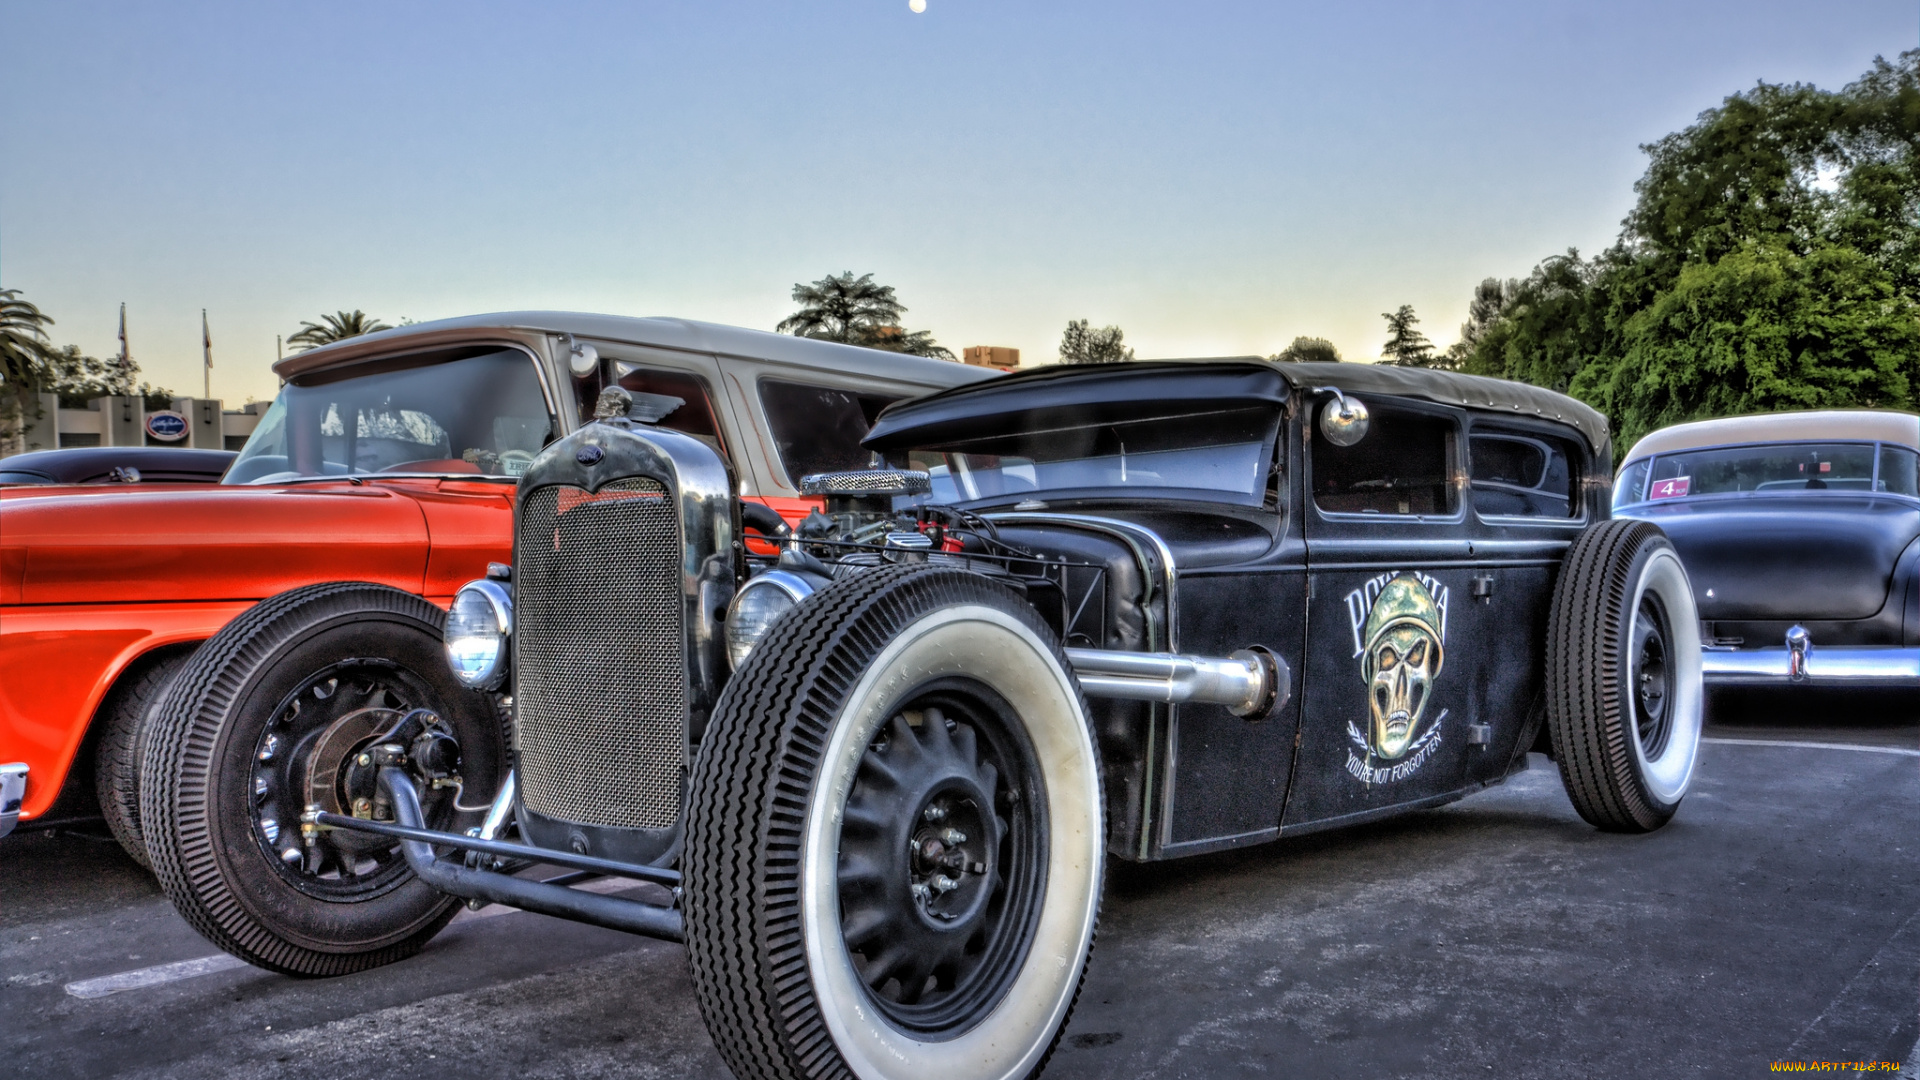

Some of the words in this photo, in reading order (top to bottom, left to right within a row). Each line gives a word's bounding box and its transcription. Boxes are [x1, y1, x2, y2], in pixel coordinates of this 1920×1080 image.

[1661, 481, 1675, 495] 4
[1372, 768, 1391, 783] NOT
[1391, 731, 1441, 782] FORGOTTEN
